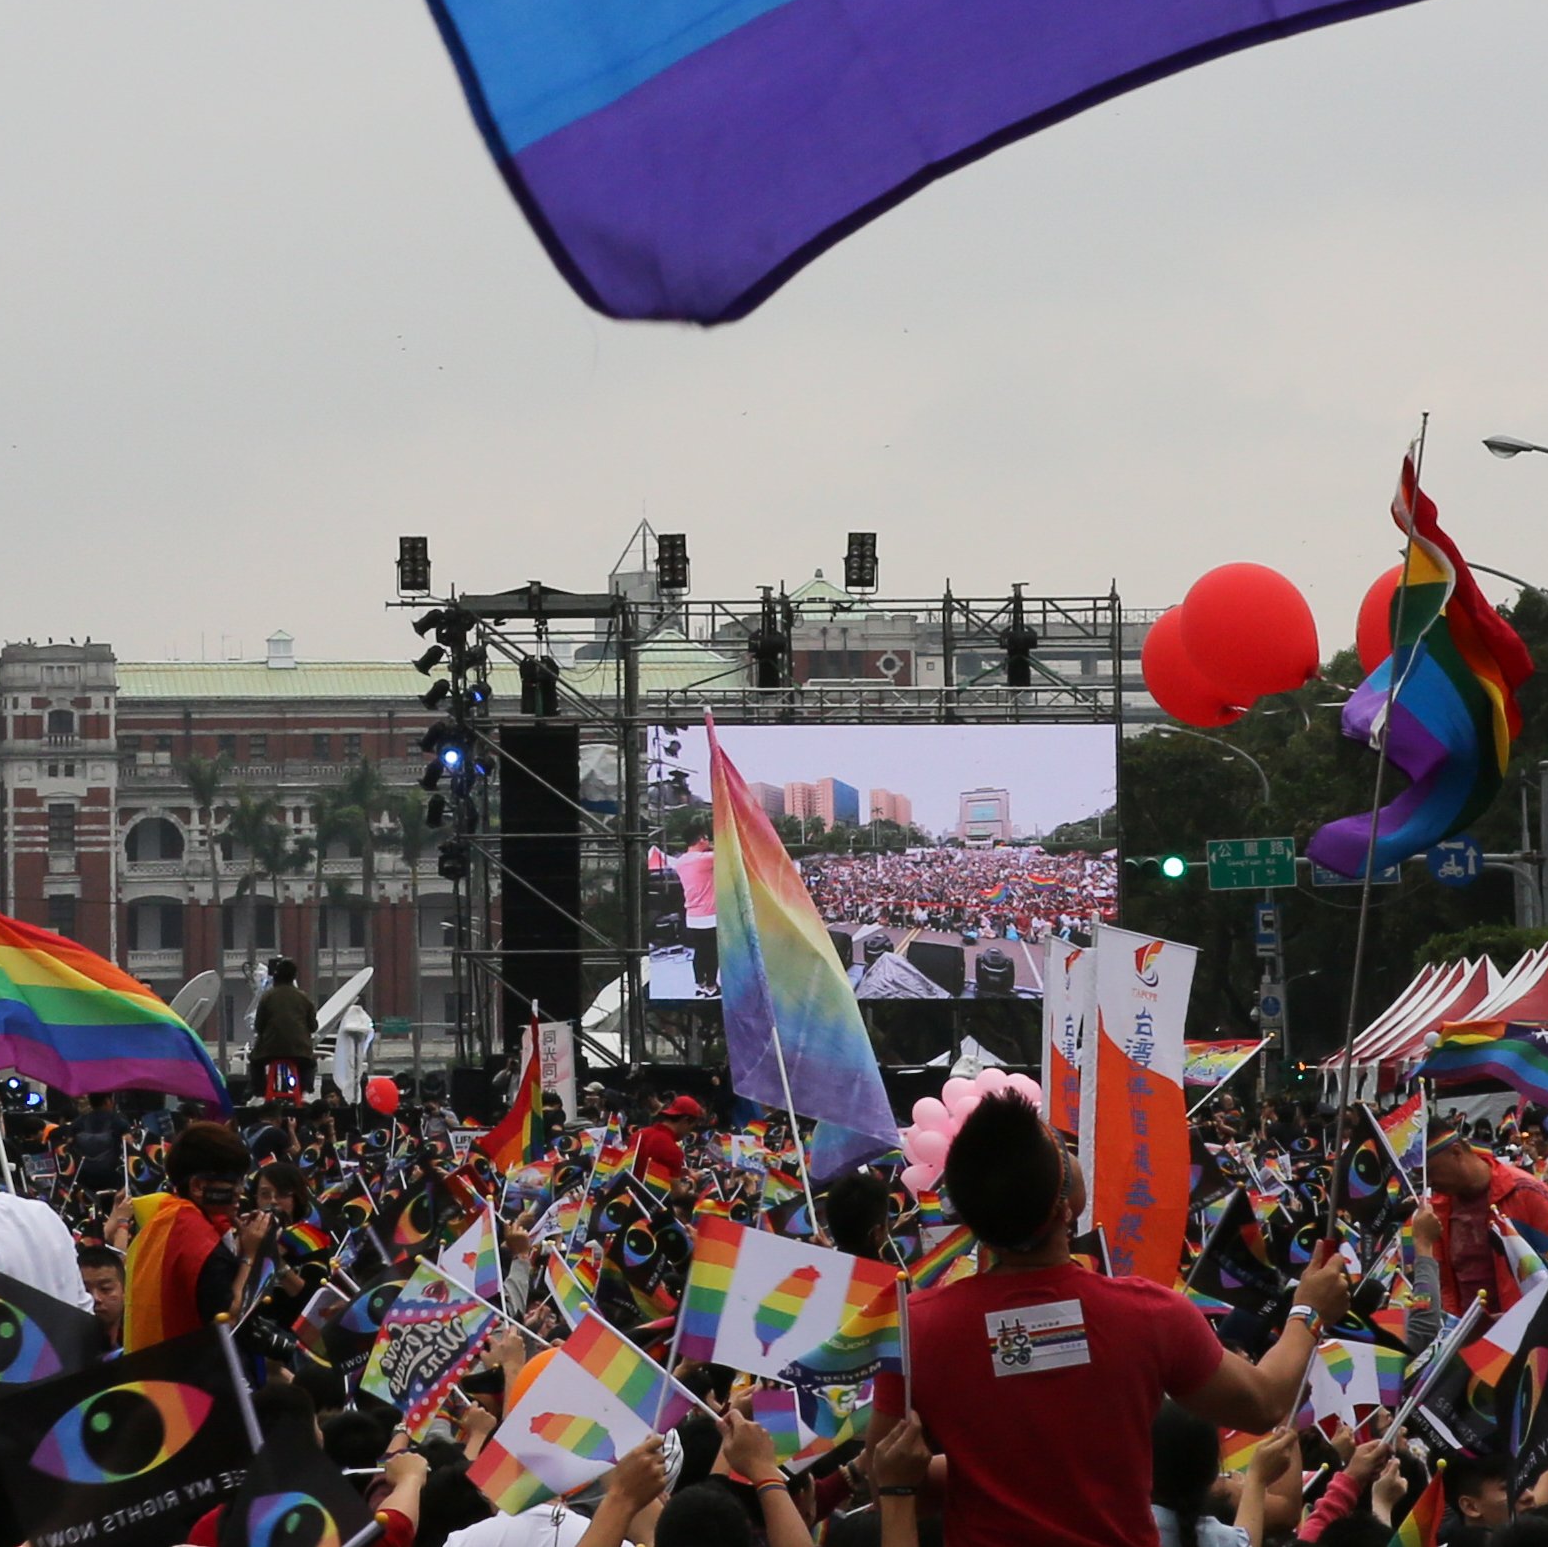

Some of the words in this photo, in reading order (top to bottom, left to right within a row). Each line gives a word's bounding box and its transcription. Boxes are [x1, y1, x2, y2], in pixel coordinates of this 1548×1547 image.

[1218, 841, 1284, 858] 公園路
[1409, 1411, 1431, 1433] GHTS
[1426, 1430, 1450, 1451] NOW!
